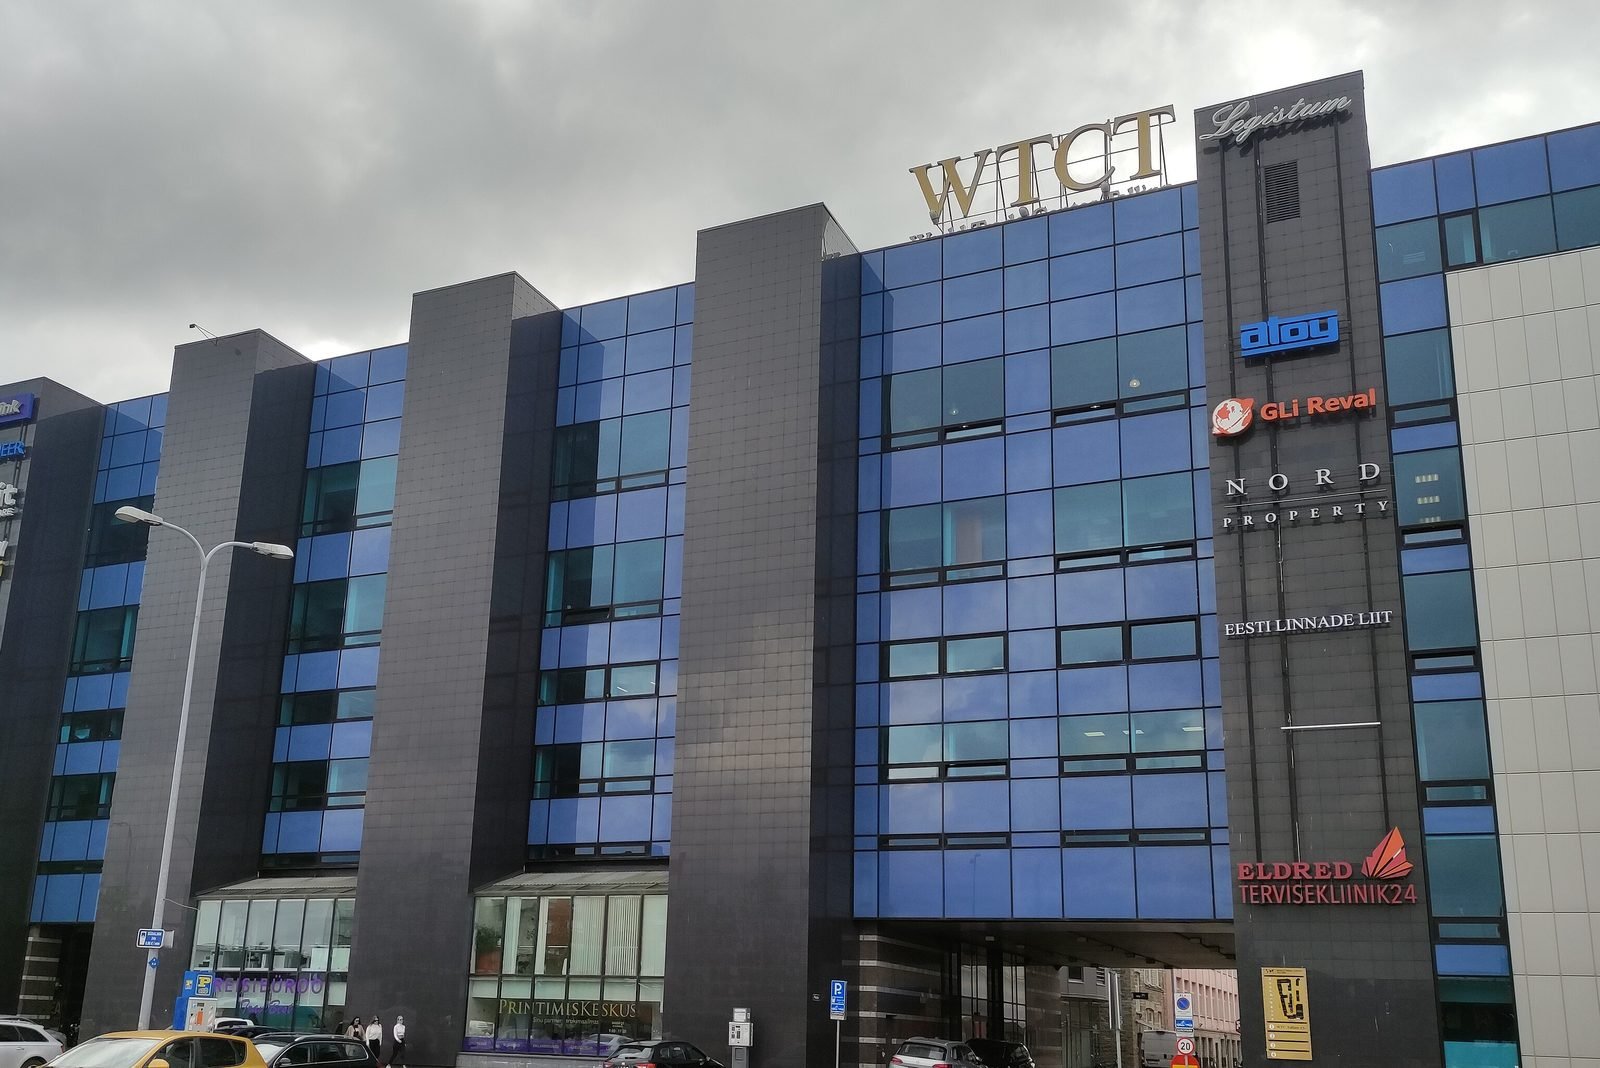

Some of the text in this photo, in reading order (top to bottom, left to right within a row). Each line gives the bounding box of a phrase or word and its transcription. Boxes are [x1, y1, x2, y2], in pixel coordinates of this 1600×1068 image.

[1199, 96, 1352, 145] Legistum
[909, 104, 1176, 219] WTCT
[1307, 388, 1376, 415] Reval
[1225, 463, 1380, 496] NORD
[1223, 500, 1389, 528] PROPERTY
[1224, 610, 1393, 636] EESTI LINNADE LIIT
[1237, 861, 1353, 880] ELDRED
[1239, 883, 1418, 904] TERVISEKLIINIK24
[198, 976, 211, 987] P
[214, 975, 323, 994] REISIBÜROO
[498, 999, 637, 1017] PRINTIMISKESKUS
[1180, 1041, 1191, 1051] 20
